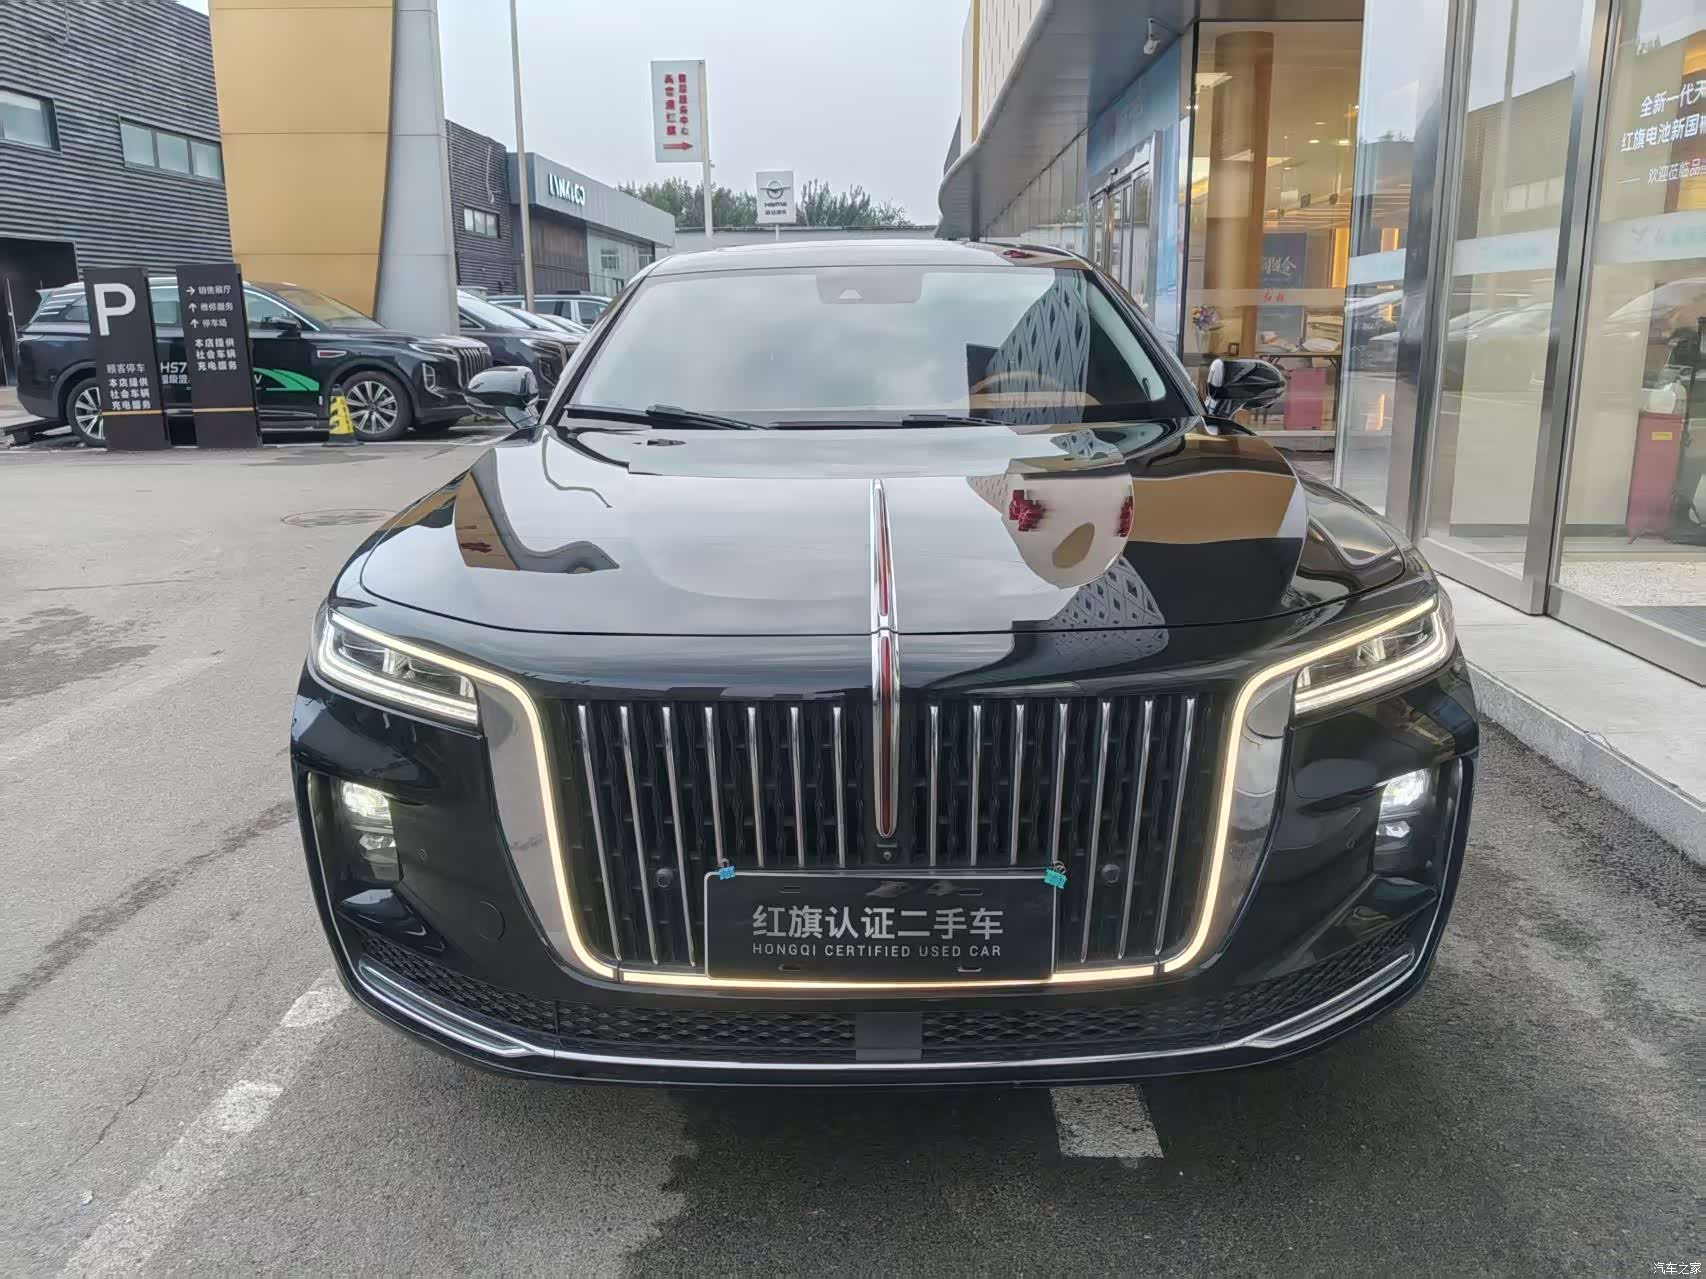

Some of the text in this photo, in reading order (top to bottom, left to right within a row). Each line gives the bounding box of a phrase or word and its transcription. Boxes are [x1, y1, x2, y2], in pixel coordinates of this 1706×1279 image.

[94, 283, 136, 336] P
[202, 318, 227, 328] 停车场
[107, 363, 145, 374] 顾客停车
[160, 361, 187, 374] HS7
[752, 905, 1003, 940] 红旗认证二手车
[752, 943, 1001, 957] HONGQI CERTIFIED USED CAR
